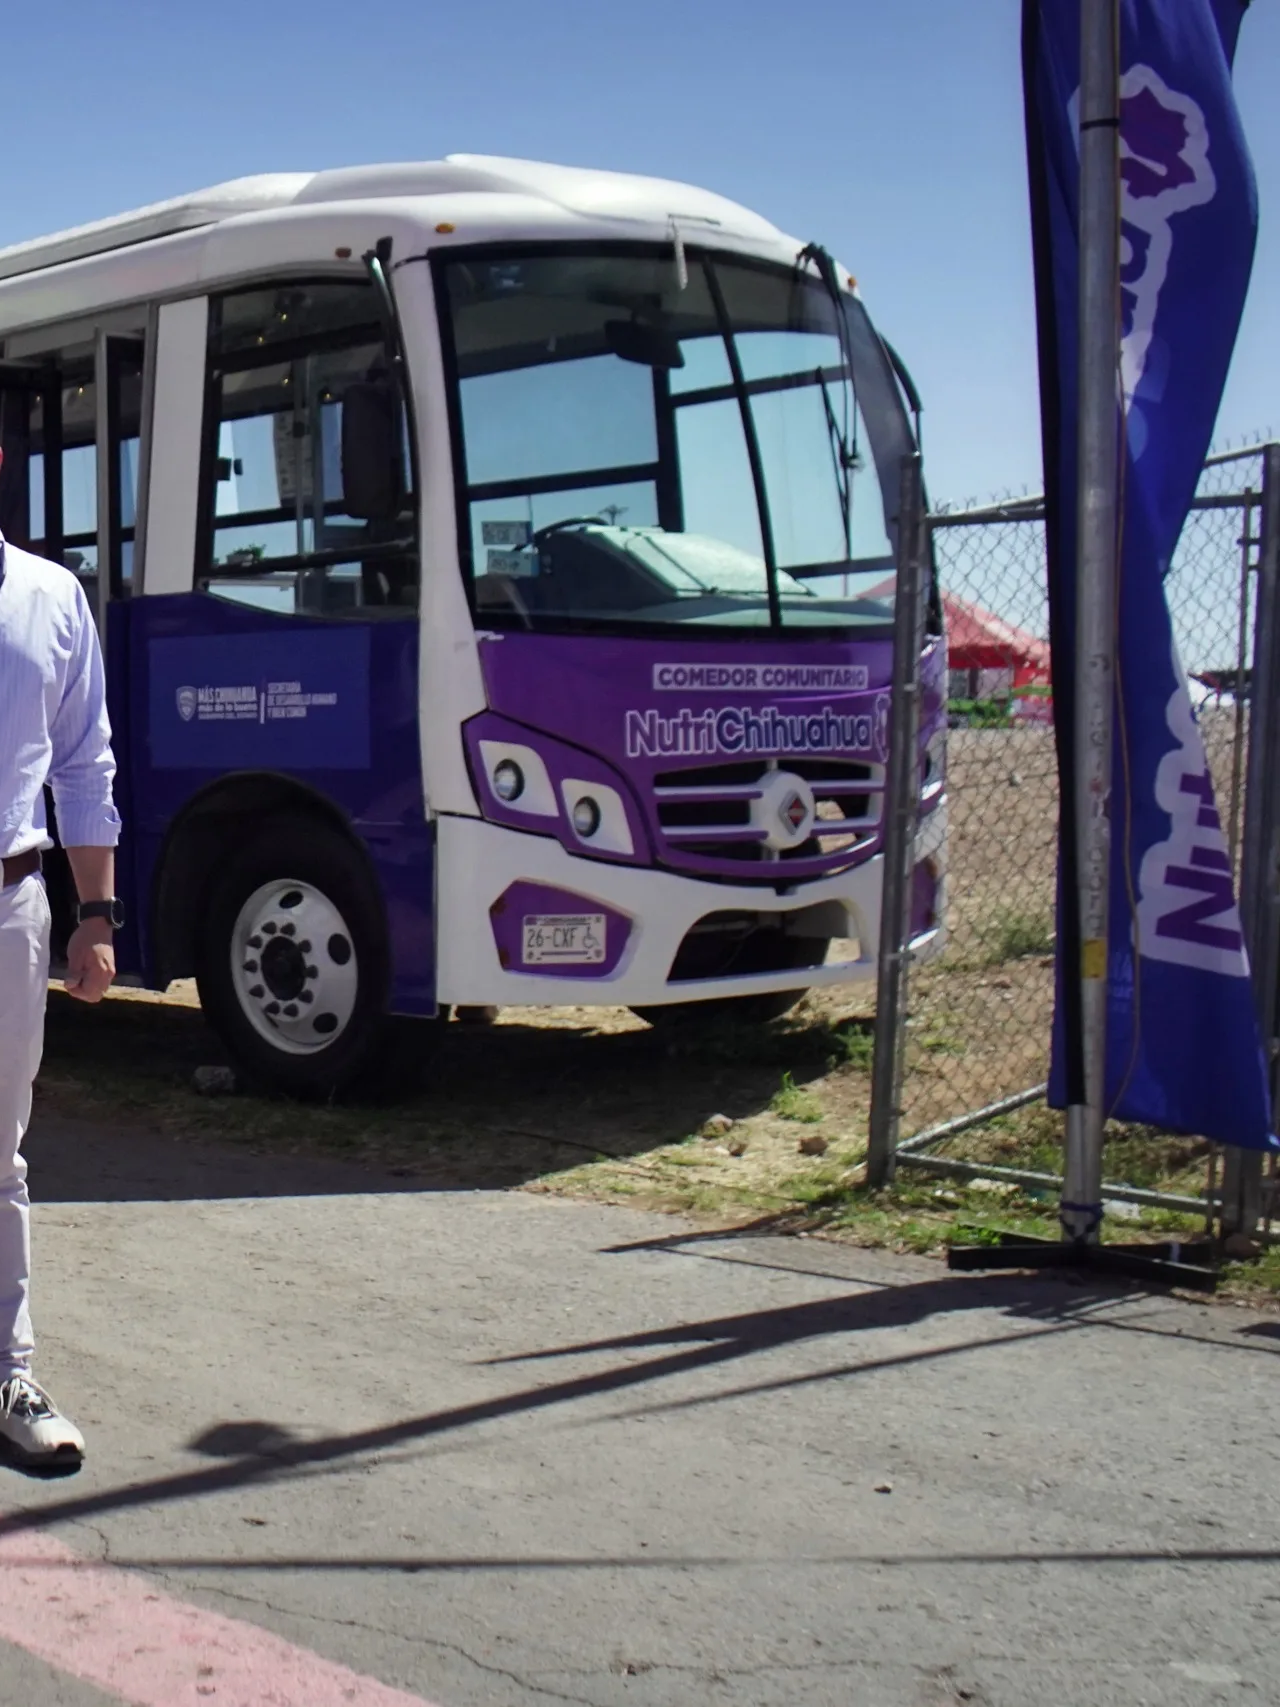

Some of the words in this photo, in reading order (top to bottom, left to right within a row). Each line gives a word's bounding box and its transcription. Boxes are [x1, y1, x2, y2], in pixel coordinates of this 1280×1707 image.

[658, 667, 757, 687] COMEDOR
[762, 668, 866, 687] COMUNITARIO
[626, 706, 871, 757] NutriChihuahua
